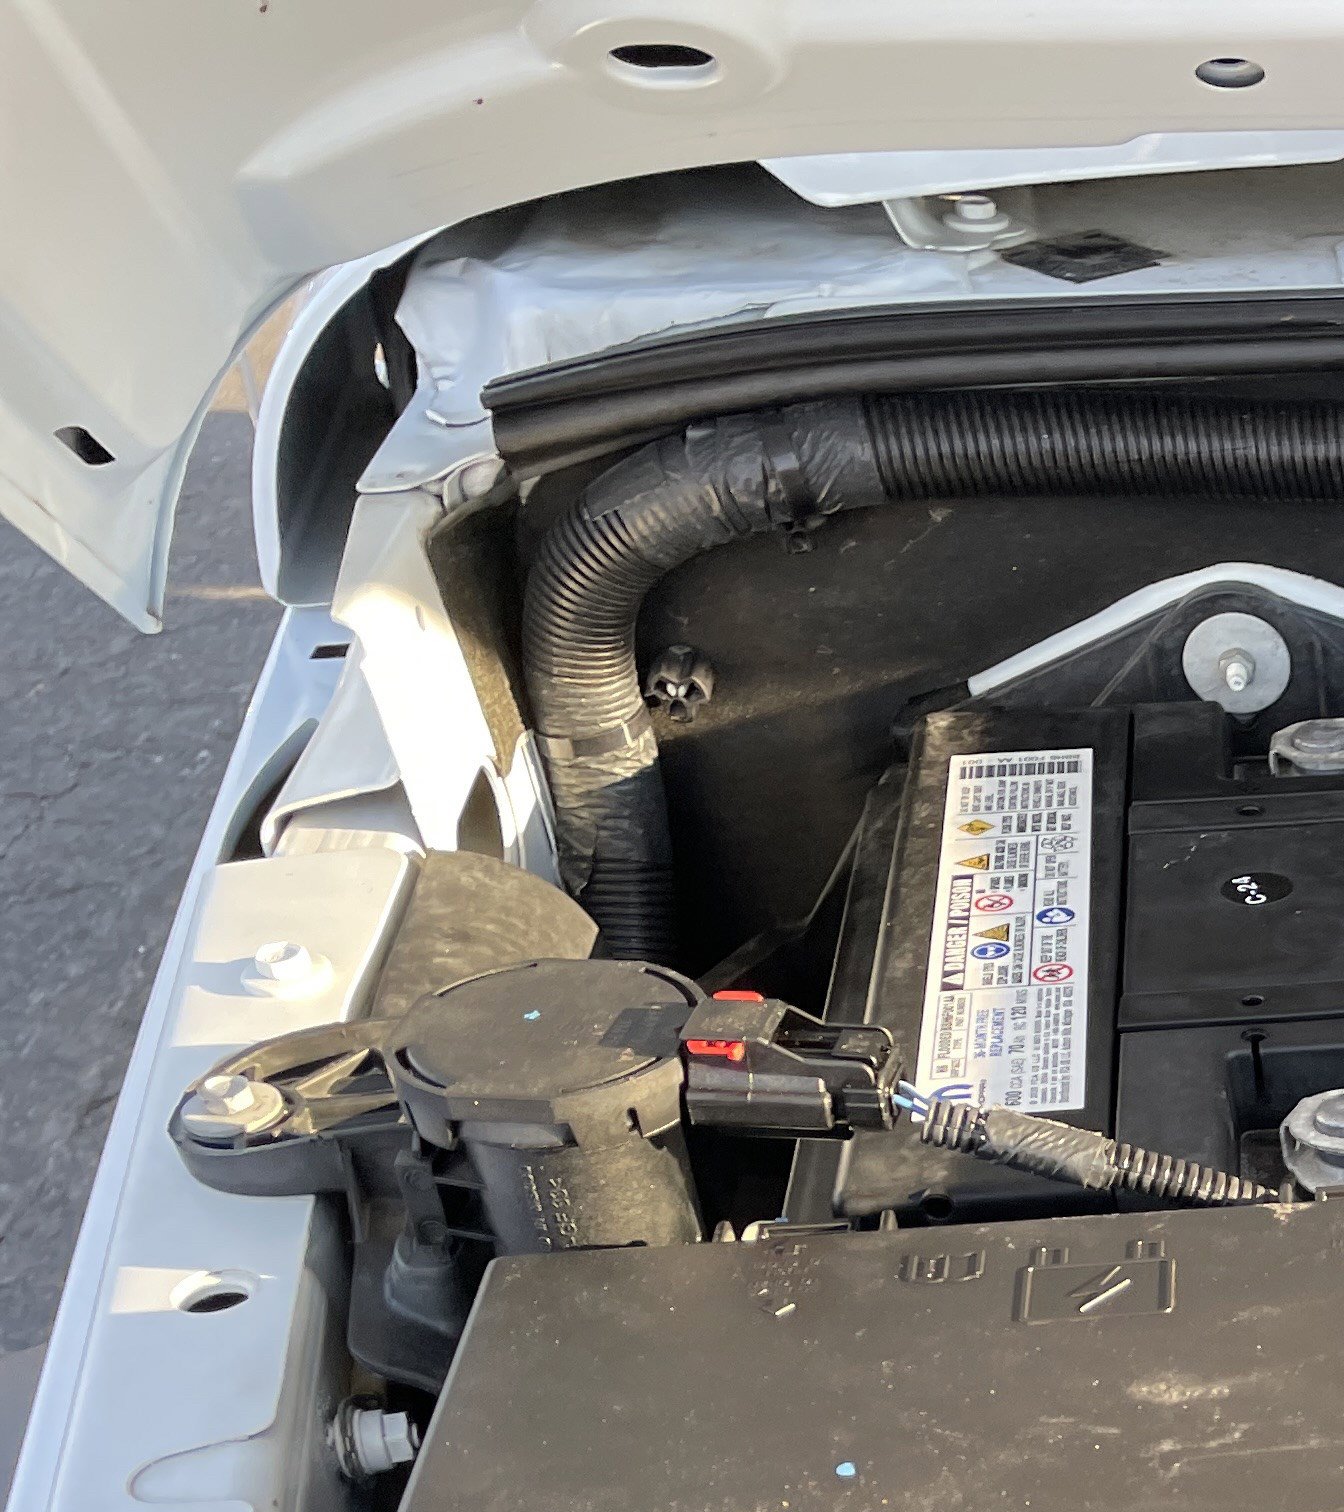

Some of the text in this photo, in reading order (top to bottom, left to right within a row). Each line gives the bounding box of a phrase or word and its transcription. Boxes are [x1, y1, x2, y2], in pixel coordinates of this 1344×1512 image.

[949, 878, 973, 917] POISON
[943, 925, 969, 971] DANGER
[989, 1007, 1005, 1058] REPLACEMENT
[1010, 1005, 1028, 1020] 120
